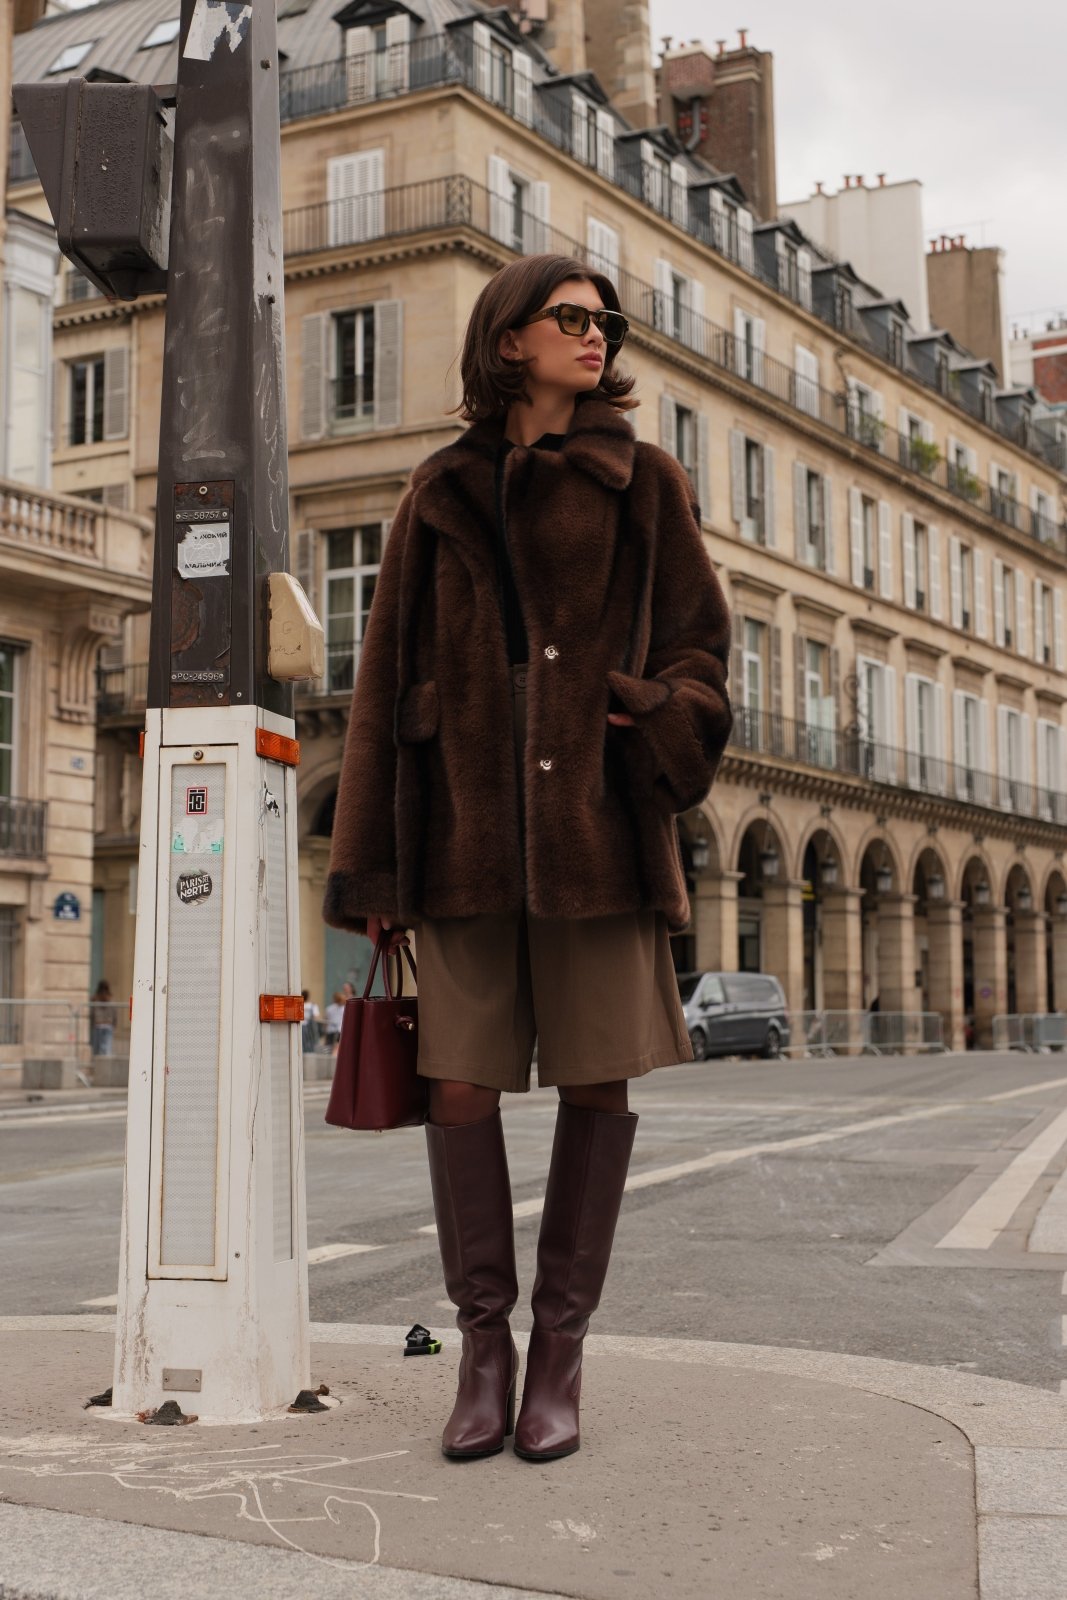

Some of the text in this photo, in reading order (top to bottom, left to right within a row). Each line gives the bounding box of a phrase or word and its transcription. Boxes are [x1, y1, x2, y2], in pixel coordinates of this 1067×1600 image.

[177, 672, 219, 681] PC-24596
[180, 876, 203, 891] PARIS
[180, 883, 209, 899] NORTE
